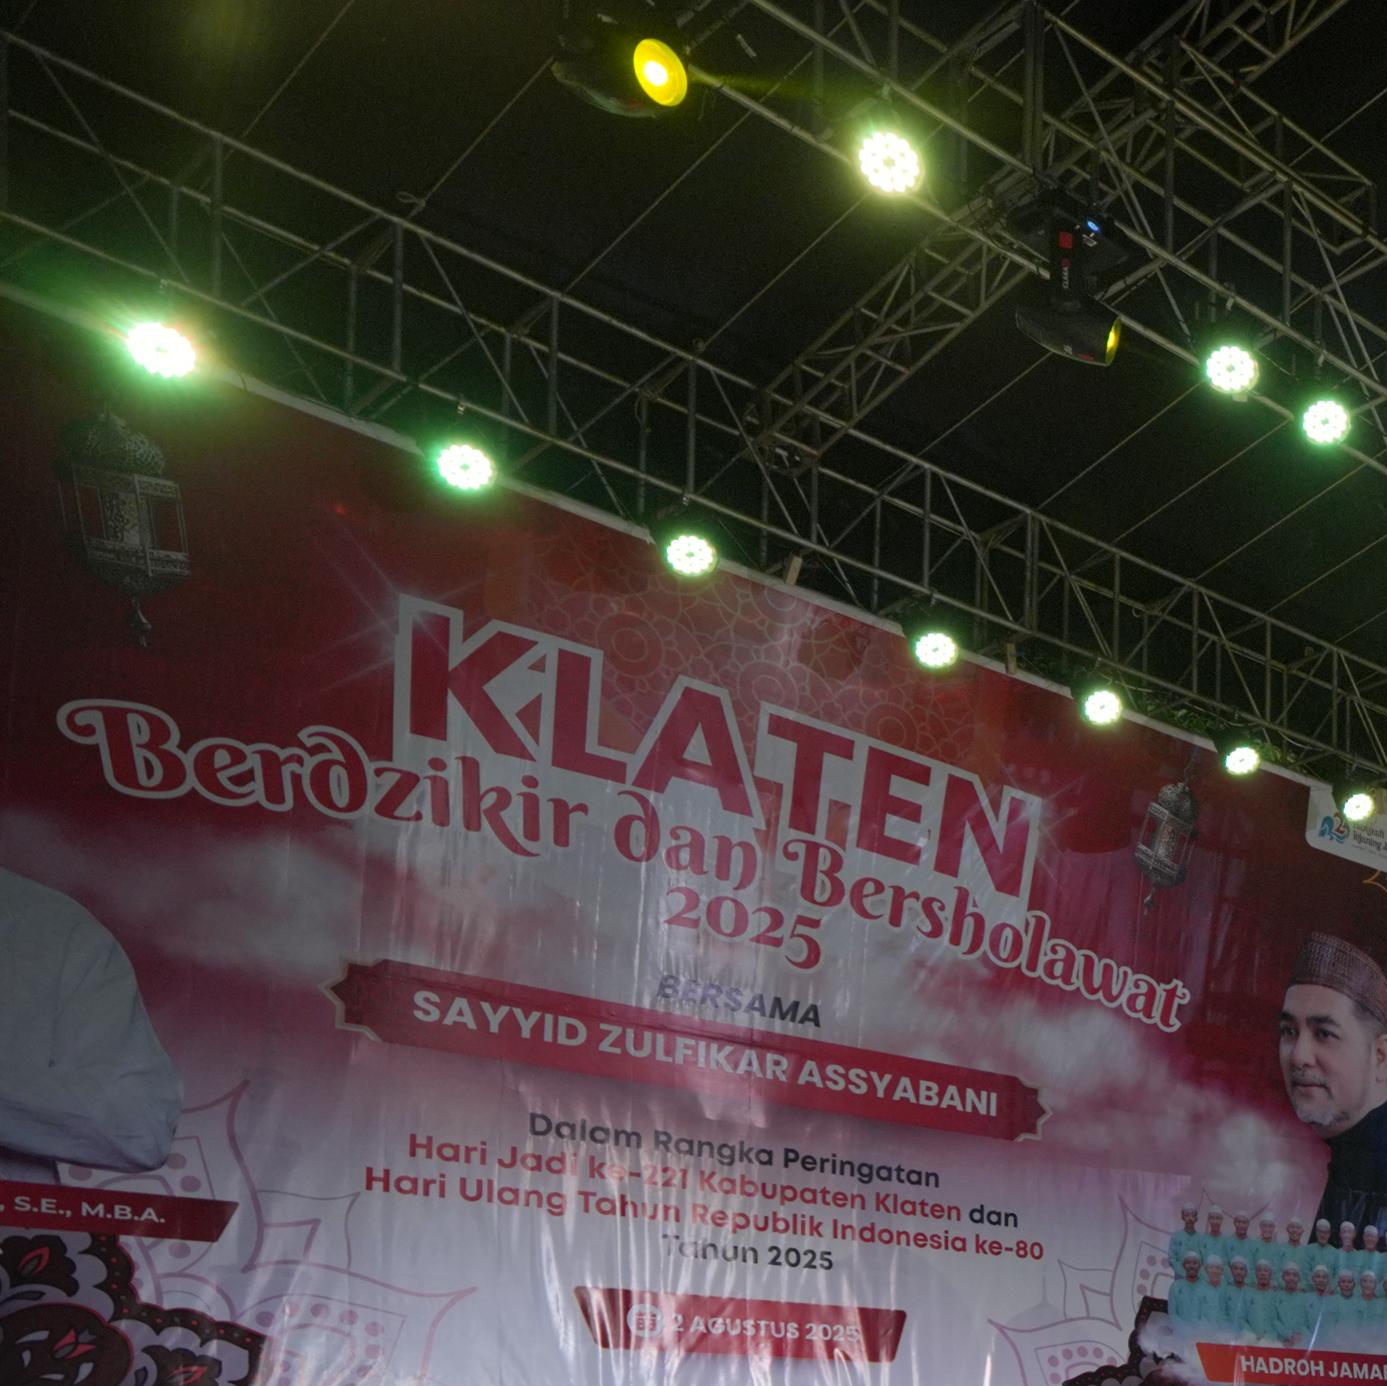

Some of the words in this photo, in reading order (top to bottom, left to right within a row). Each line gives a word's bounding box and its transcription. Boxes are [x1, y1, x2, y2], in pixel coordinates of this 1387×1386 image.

[405, 600, 1036, 900] KLATEN
[62, 700, 590, 858] Berdzikir
[614, 790, 758, 890] dan
[784, 839, 1188, 1031] Bersholawat
[665, 886, 822, 969] 2025
[656, 974, 821, 1028] BERSAMA
[413, 988, 587, 1048] SAYYID
[599, 1023, 788, 1083] ZULFIKAR
[798, 1059, 998, 1117] ASSYABANI
[408, 1133, 487, 1166] Hari
[497, 1147, 578, 1177] Jadi
[589, 1155, 688, 1190] ke-221
[699, 1168, 866, 1211] Kabupaten
[874, 1192, 961, 1222] Klaten
[969, 1204, 1019, 1228] dan
[529, 1112, 642, 1149] Dalam
[653, 1129, 774, 1166] Rangka
[783, 1147, 940, 1188] Peringatan
[14, 1195, 72, 1217] S.E.,
[81, 1201, 166, 1224] M.B.A.
[364, 1166, 446, 1198] Hari
[459, 1176, 566, 1217] Ulang
[577, 1189, 681, 1223] Tahun
[691, 1202, 824, 1238] Republik
[832, 1218, 967, 1253] Indonesia
[975, 1234, 1044, 1260] ke-80
[661, 1234, 758, 1264] Tahun
[768, 1245, 834, 1270] 2025
[690, 1315, 800, 1339] AGUSTUS
[805, 1322, 862, 1342] 2025
[1241, 1355, 1326, 1378] HADROH
